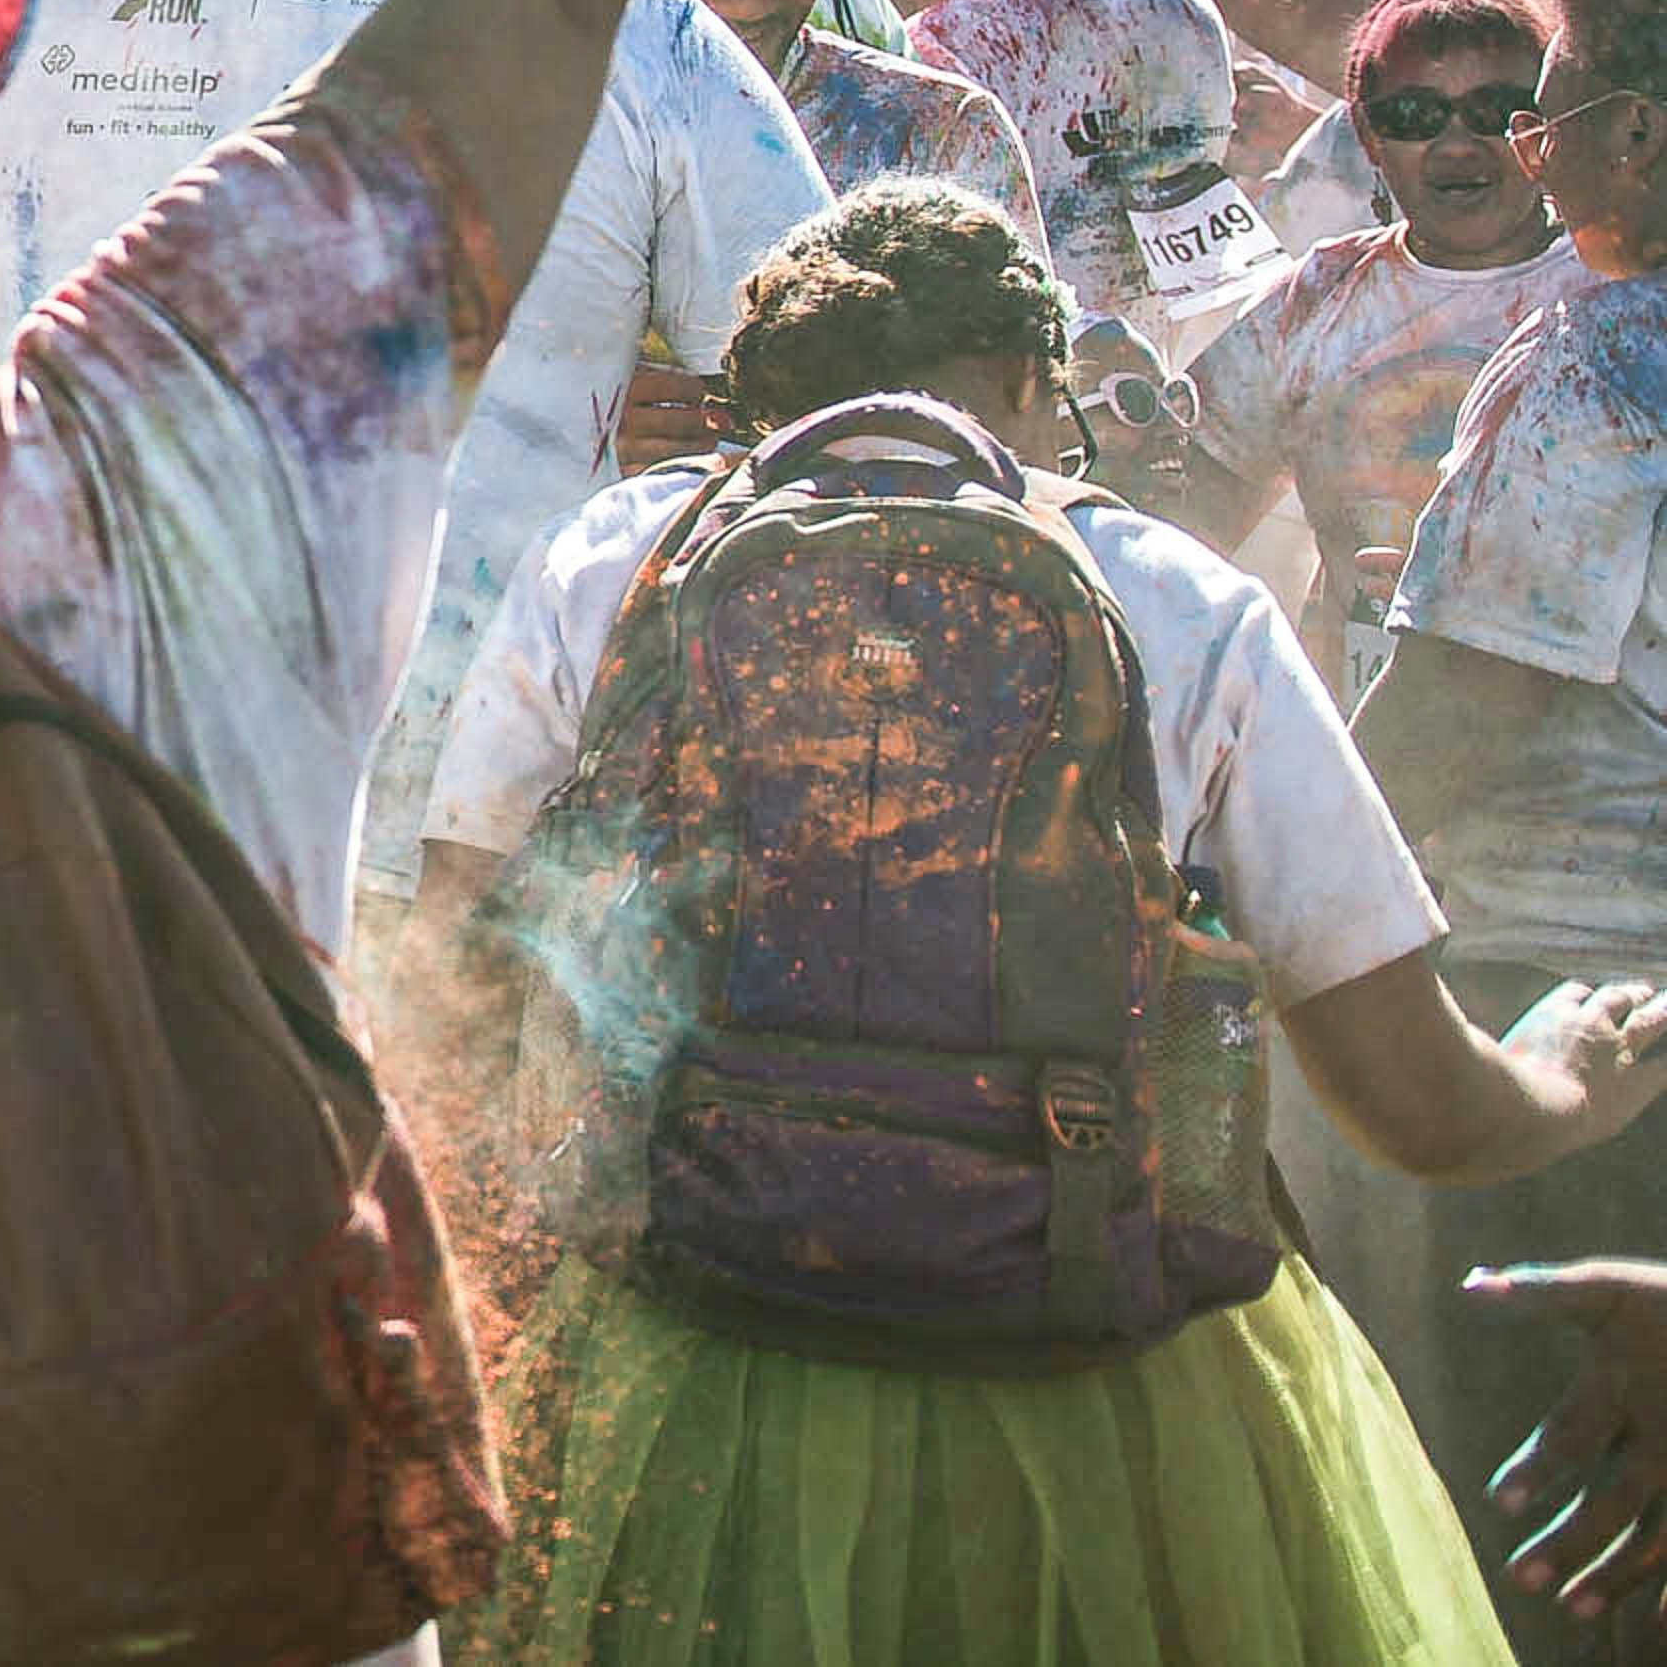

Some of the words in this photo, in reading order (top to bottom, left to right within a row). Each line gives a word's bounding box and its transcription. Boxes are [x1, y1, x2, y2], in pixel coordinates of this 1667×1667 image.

[71, 67, 219, 101] medihelp
[67, 120, 94, 136] fun
[111, 120, 131, 136] fit
[147, 120, 217, 140] healthy
[1141, 203, 1256, 268] 116749
